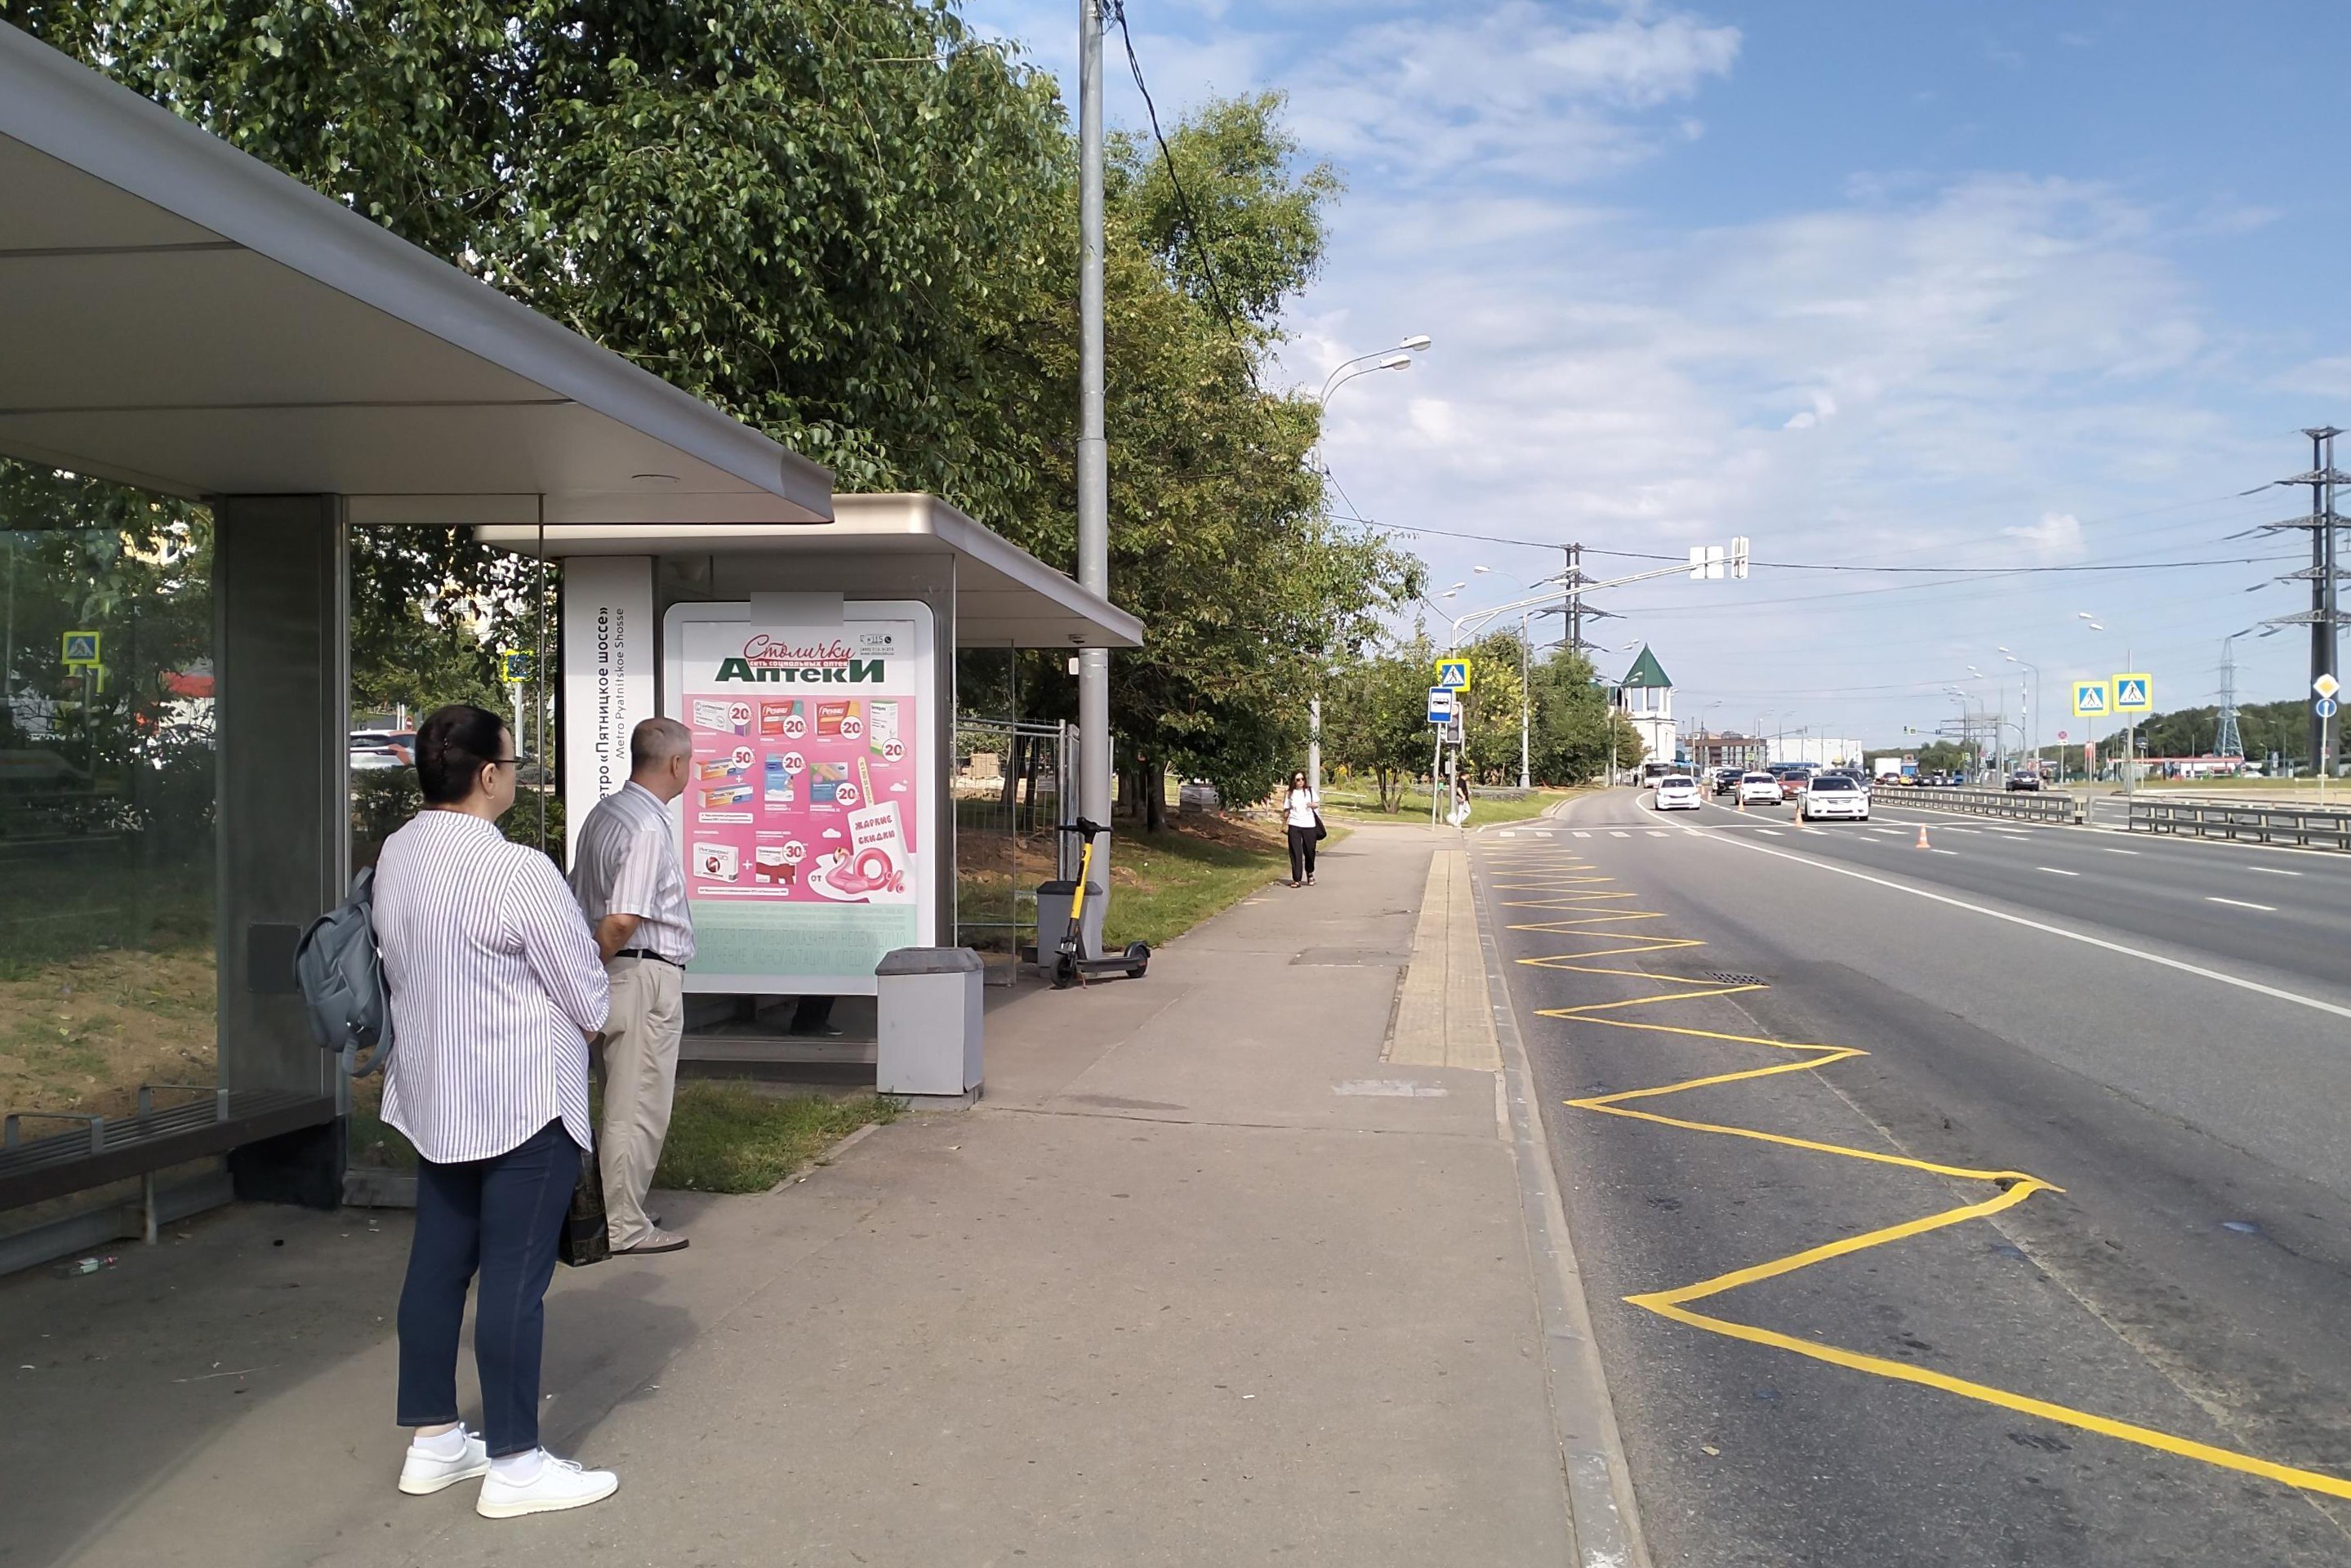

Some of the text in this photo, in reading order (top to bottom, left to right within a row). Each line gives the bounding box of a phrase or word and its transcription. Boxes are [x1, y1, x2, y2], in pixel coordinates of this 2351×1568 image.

[744, 634, 857, 660] Столички
[769, 660, 822, 668] социальных
[614, 608, 626, 760] Metro Pyatnitskoe Shosse
[595, 607, 612, 801] етро «Пятницкое шоссе»
[854, 815, 893, 830] ЖАРКИЕ
[858, 830, 896, 844] СКИДКИ
